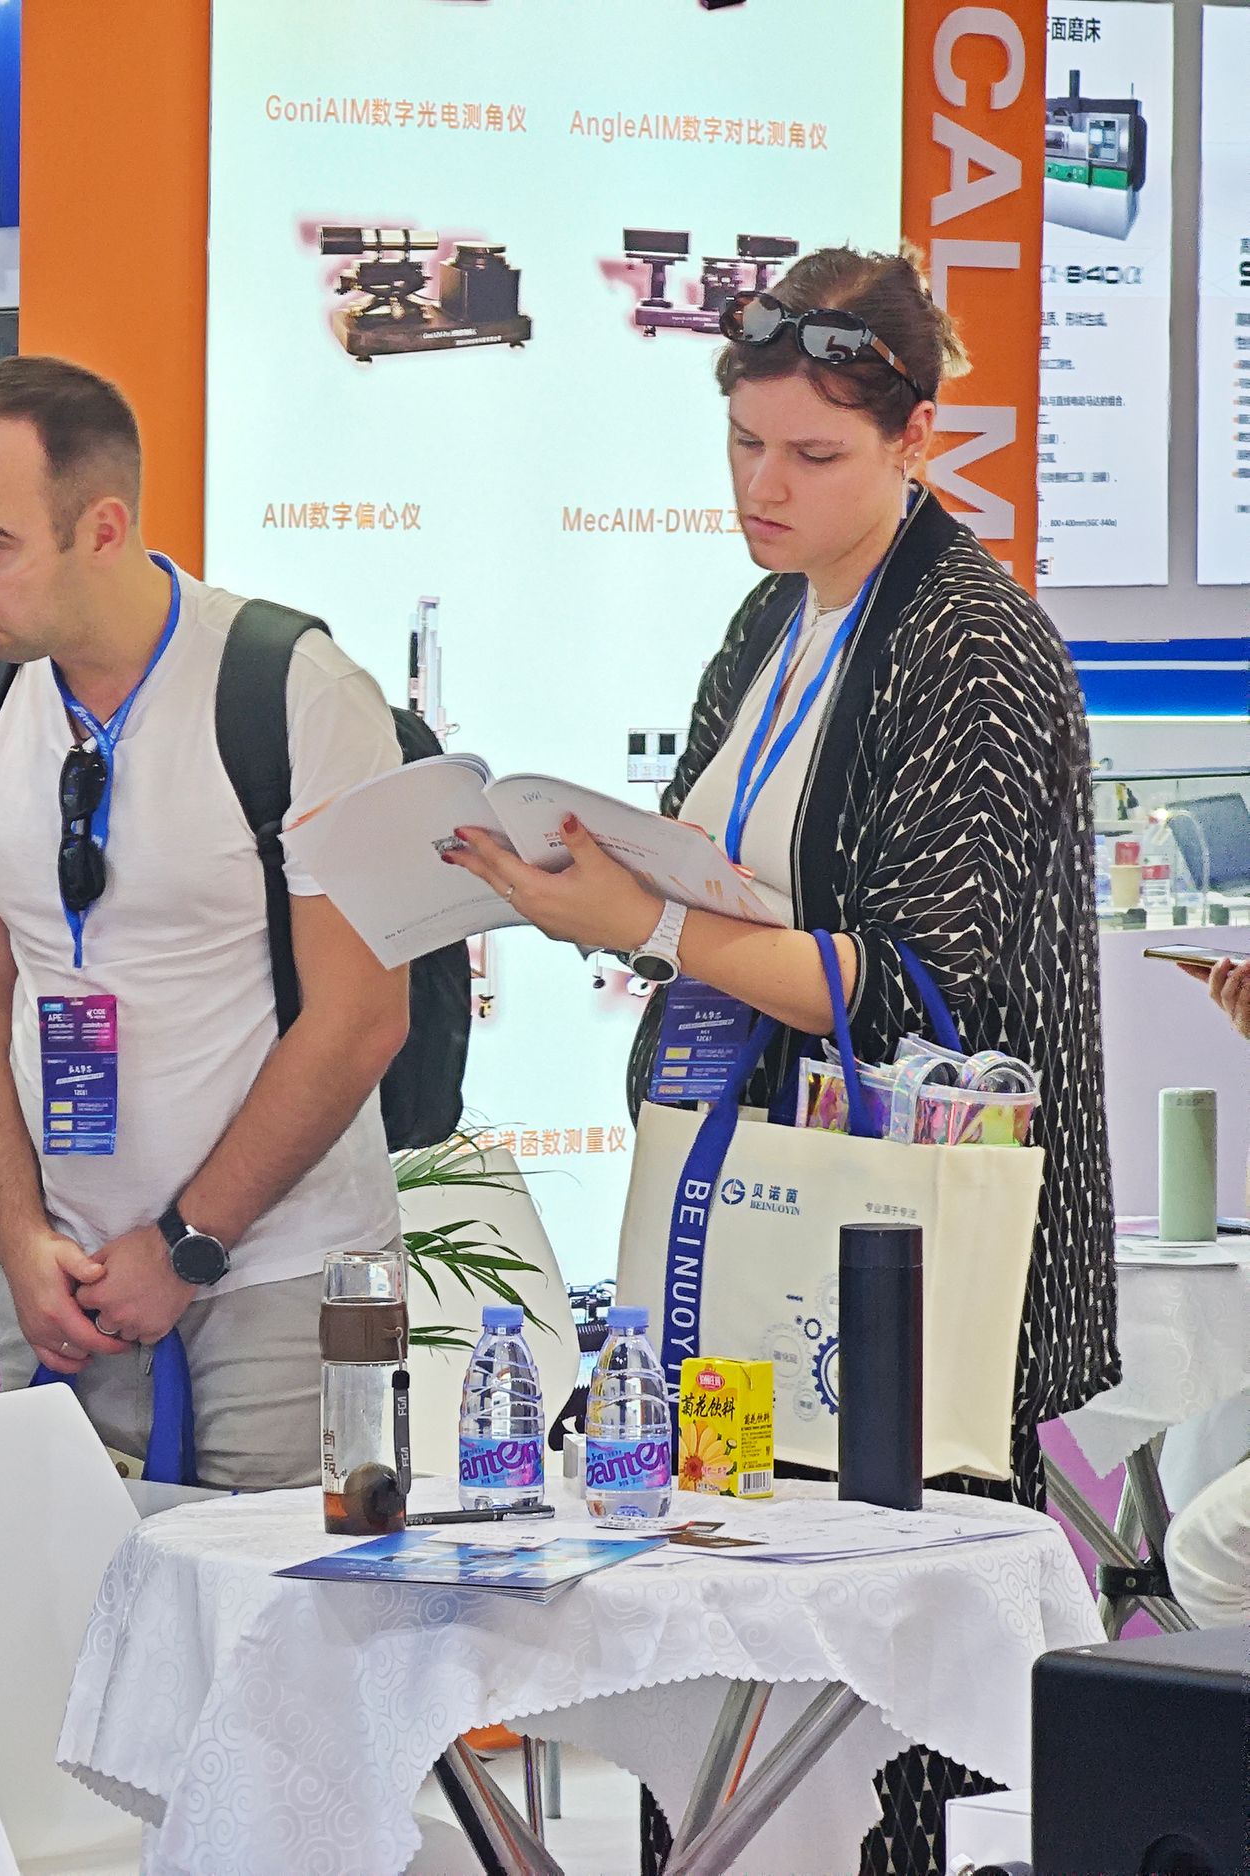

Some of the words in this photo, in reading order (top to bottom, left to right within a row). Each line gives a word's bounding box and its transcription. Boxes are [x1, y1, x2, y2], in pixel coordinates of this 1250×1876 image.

[1047, 16, 1101, 43] 面磨床
[265, 94, 527, 133] GoniAIM数字光电测角仪
[569, 109, 828, 150] AngleAIM数字对比测角仪
[262, 502, 421, 531] AIM数字偏心仪
[750, 1199, 800, 1216] BEINUOYIN
[681, 1392, 736, 1422] 菊花饮料
[459, 1440, 539, 1482] anten
